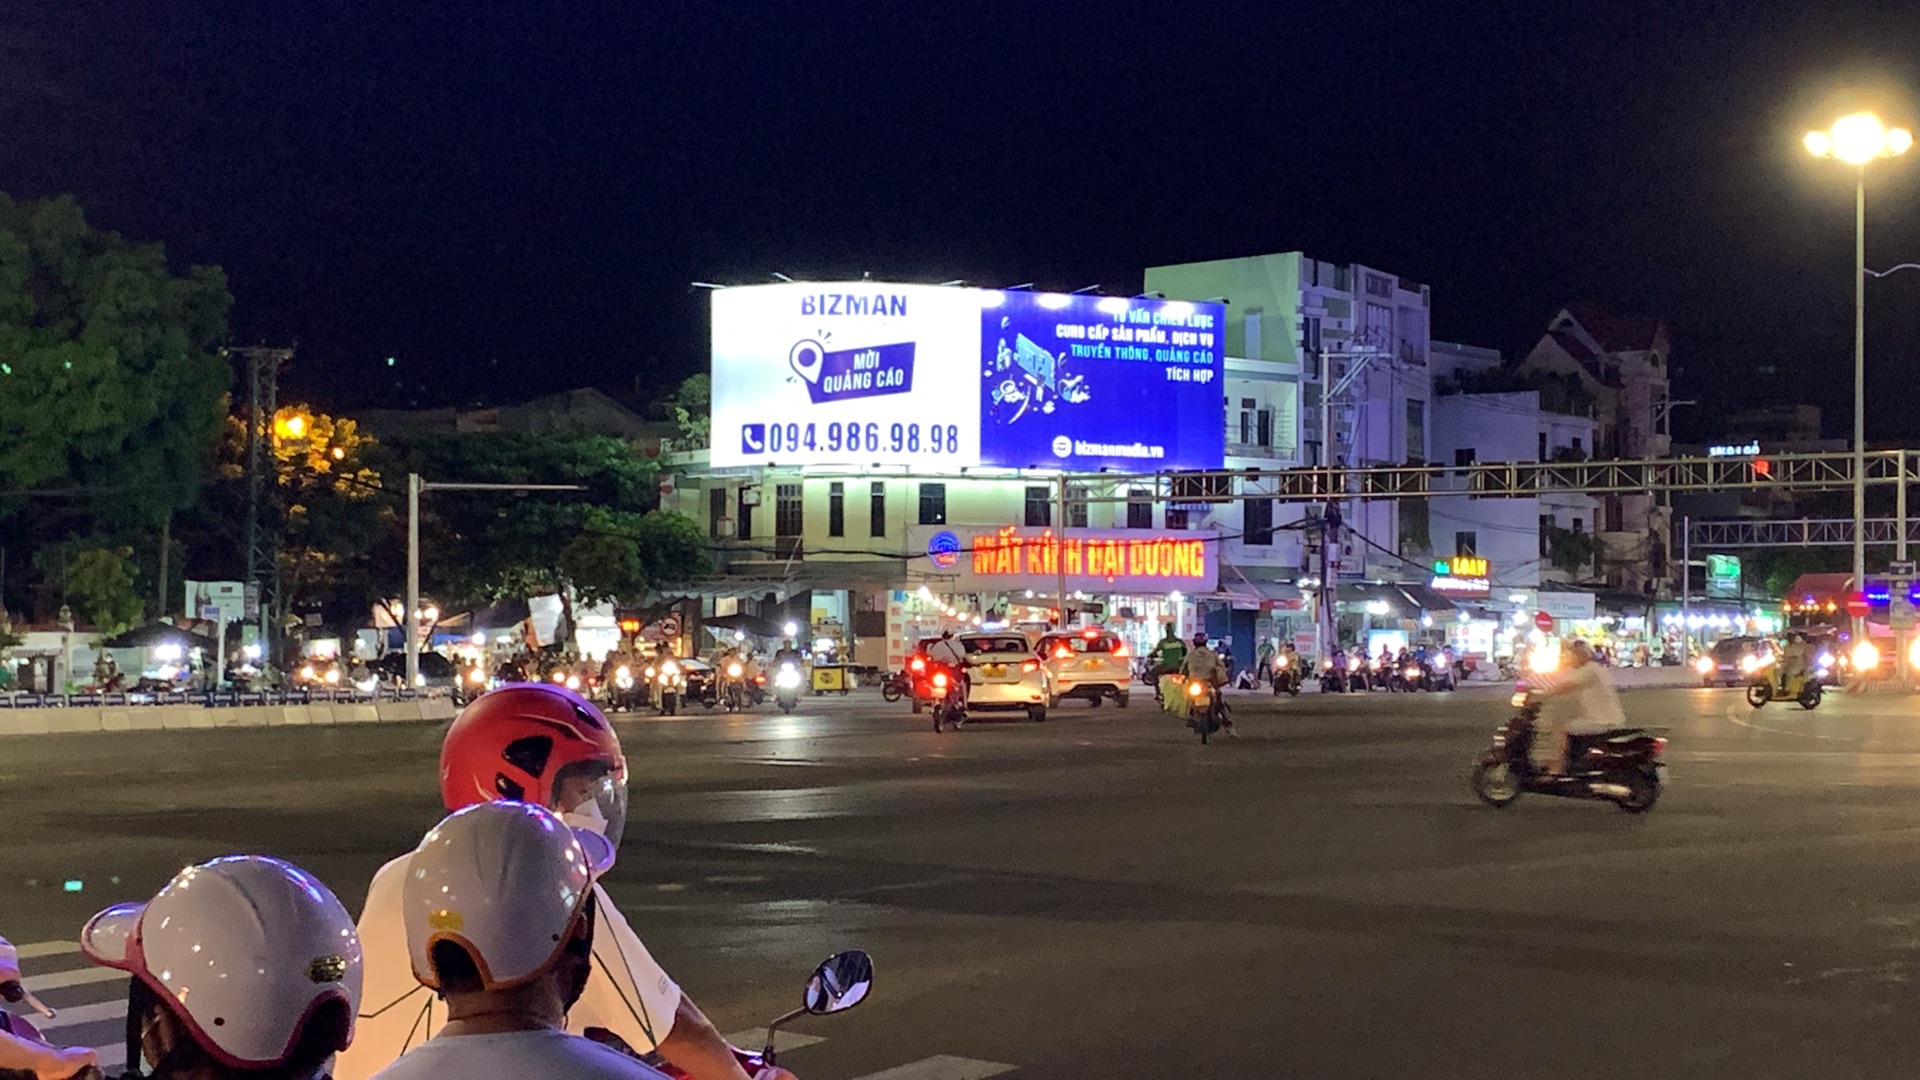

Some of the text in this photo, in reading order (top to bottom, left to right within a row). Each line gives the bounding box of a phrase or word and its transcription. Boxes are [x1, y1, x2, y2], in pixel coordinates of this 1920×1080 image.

[801, 294, 907, 316] BIZMAN
[1056, 324, 1085, 339] CUNG
[1087, 323, 1109, 340] CẤP
[1111, 324, 1133, 342] SẢN
[1172, 331, 1198, 347] DỊCH
[1199, 333, 1214, 348] VỤ
[853, 349, 880, 370] MỜI
[1155, 347, 1190, 363] QUẢNG
[1193, 350, 1214, 364] CÁO
[823, 366, 904, 394] QUẢNG CÁO
[1165, 366, 1214, 384] TÍCH HỢP
[770, 422, 958, 454] 094.986.98.98
[1075, 440, 1164, 458] bizmanmedia.vn
[973, 525, 1204, 583] MẮT KÍNH ĐẠI DƯƠNG
[1453, 557, 1487, 576] LOAN
